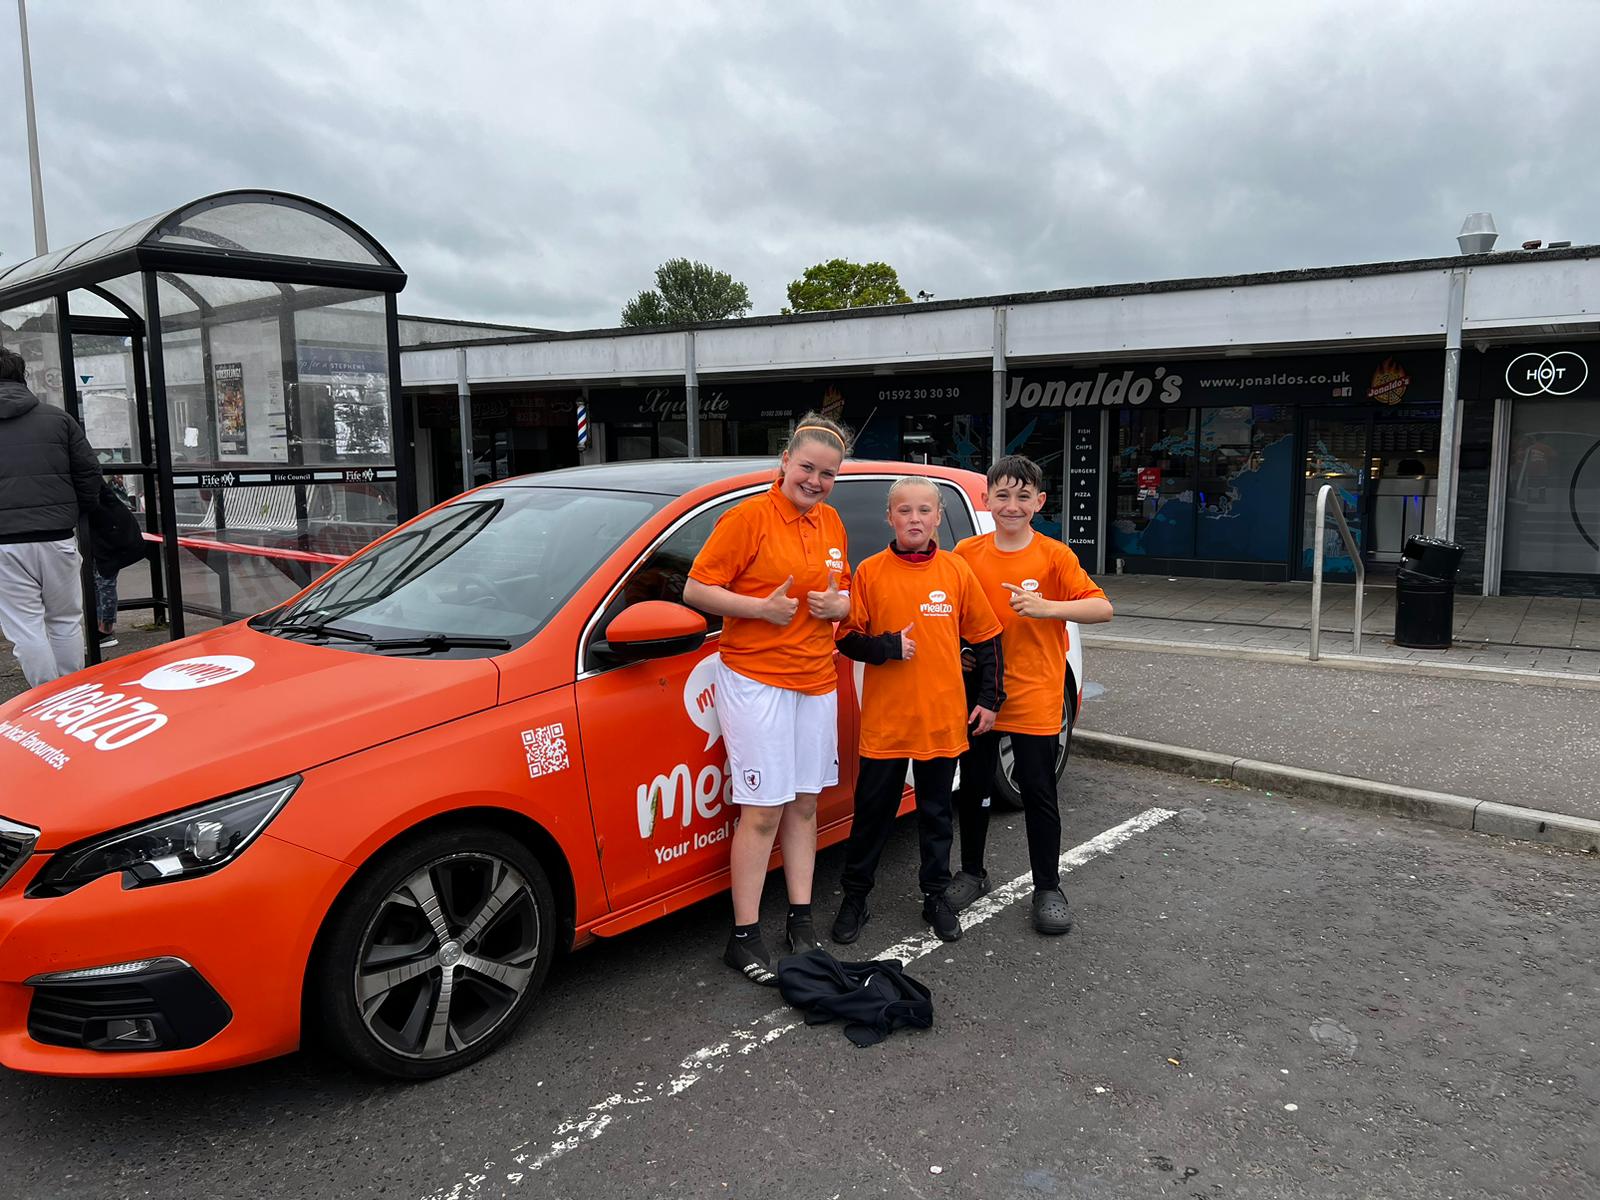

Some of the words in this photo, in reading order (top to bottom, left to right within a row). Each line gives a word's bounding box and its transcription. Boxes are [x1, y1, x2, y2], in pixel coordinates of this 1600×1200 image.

[1200, 371, 1350, 389] www.jonaldos.co.uk
[1526, 368, 1567, 381] HOT
[878, 389, 911, 401] 01592
[913, 389, 927, 399] 30
[930, 388, 944, 398] 30
[946, 387, 960, 398] 30
[1004, 366, 1183, 409] Jonaldo's
[1367, 377, 1410, 398] Jonaldo's
[202, 475, 220, 485] Fife
[346, 471, 361, 480] Fife
[22, 683, 169, 751] mealzo
[654, 840, 690, 865] Your
[693, 821, 730, 849] local
